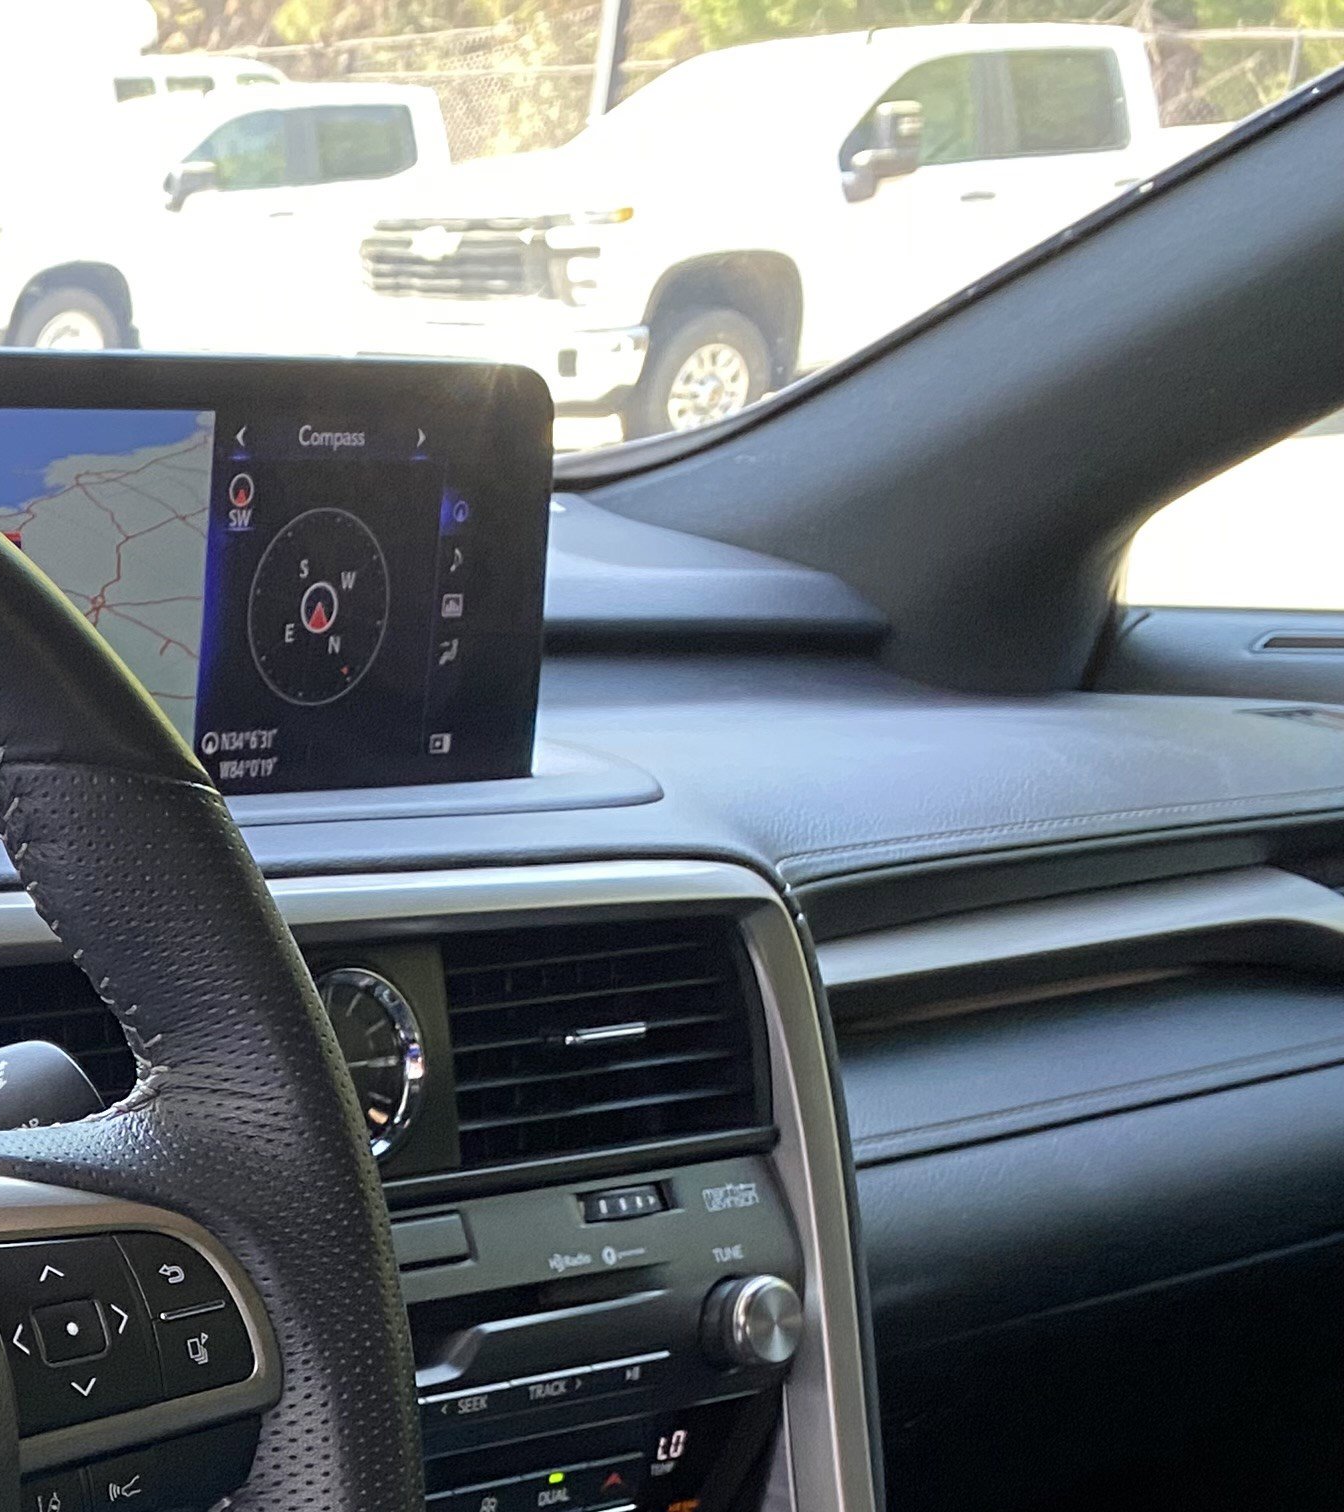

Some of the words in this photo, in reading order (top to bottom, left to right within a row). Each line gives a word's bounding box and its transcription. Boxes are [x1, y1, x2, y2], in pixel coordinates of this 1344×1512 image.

[298, 425, 366, 450] Compass
[228, 509, 253, 528] SW
[299, 559, 310, 579] S
[341, 571, 357, 590] W
[284, 623, 296, 643] E
[328, 636, 342, 654] N
[528, 1379, 567, 1401] TRACK
[457, 1395, 489, 1415] SEEK
